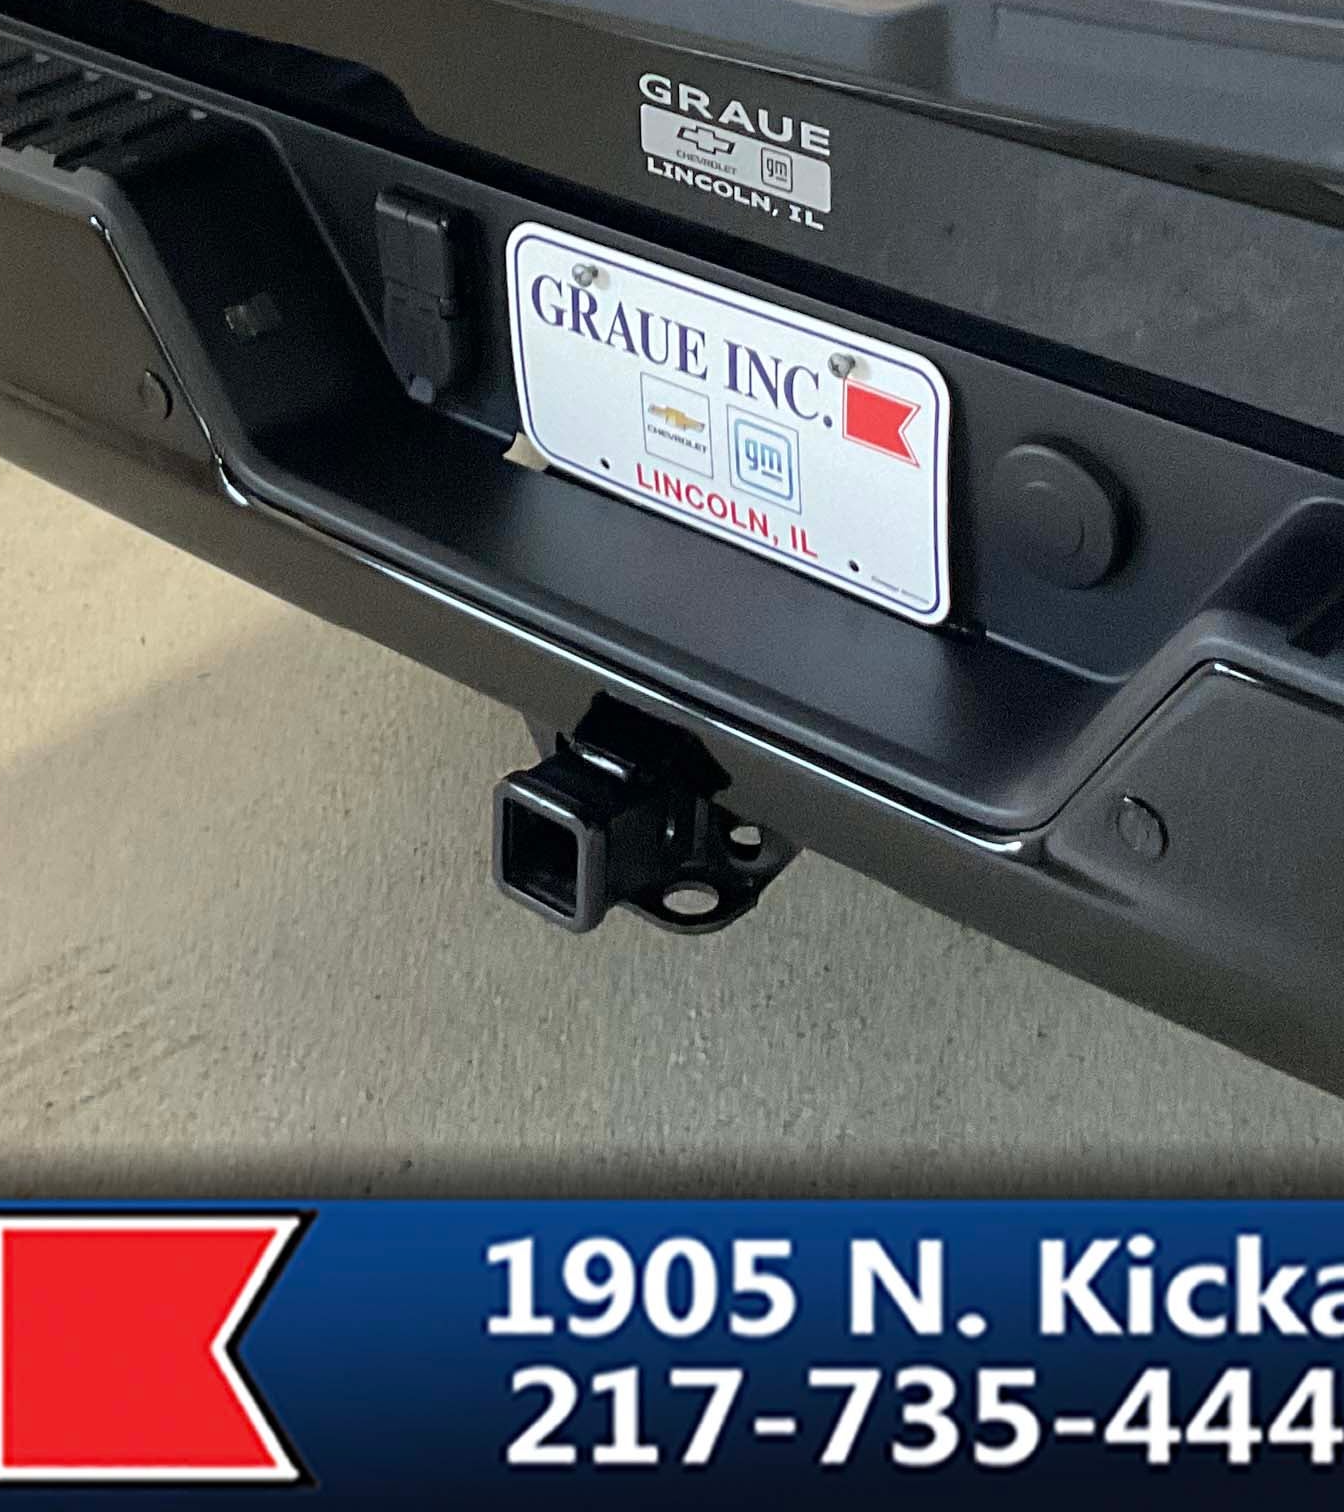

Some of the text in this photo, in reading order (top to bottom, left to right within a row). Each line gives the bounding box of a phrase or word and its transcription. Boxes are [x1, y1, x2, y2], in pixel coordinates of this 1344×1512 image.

[639, 73, 831, 156] GRAUE
[675, 148, 738, 176] CHEVROLET
[766, 157, 788, 183] gm
[647, 157, 825, 231] LINCOLN, IL
[531, 273, 834, 429] GRAUE INC.
[647, 423, 708, 456] CHEVROLET
[744, 437, 784, 480] gm
[636, 462, 819, 558] LINCOLN, IL
